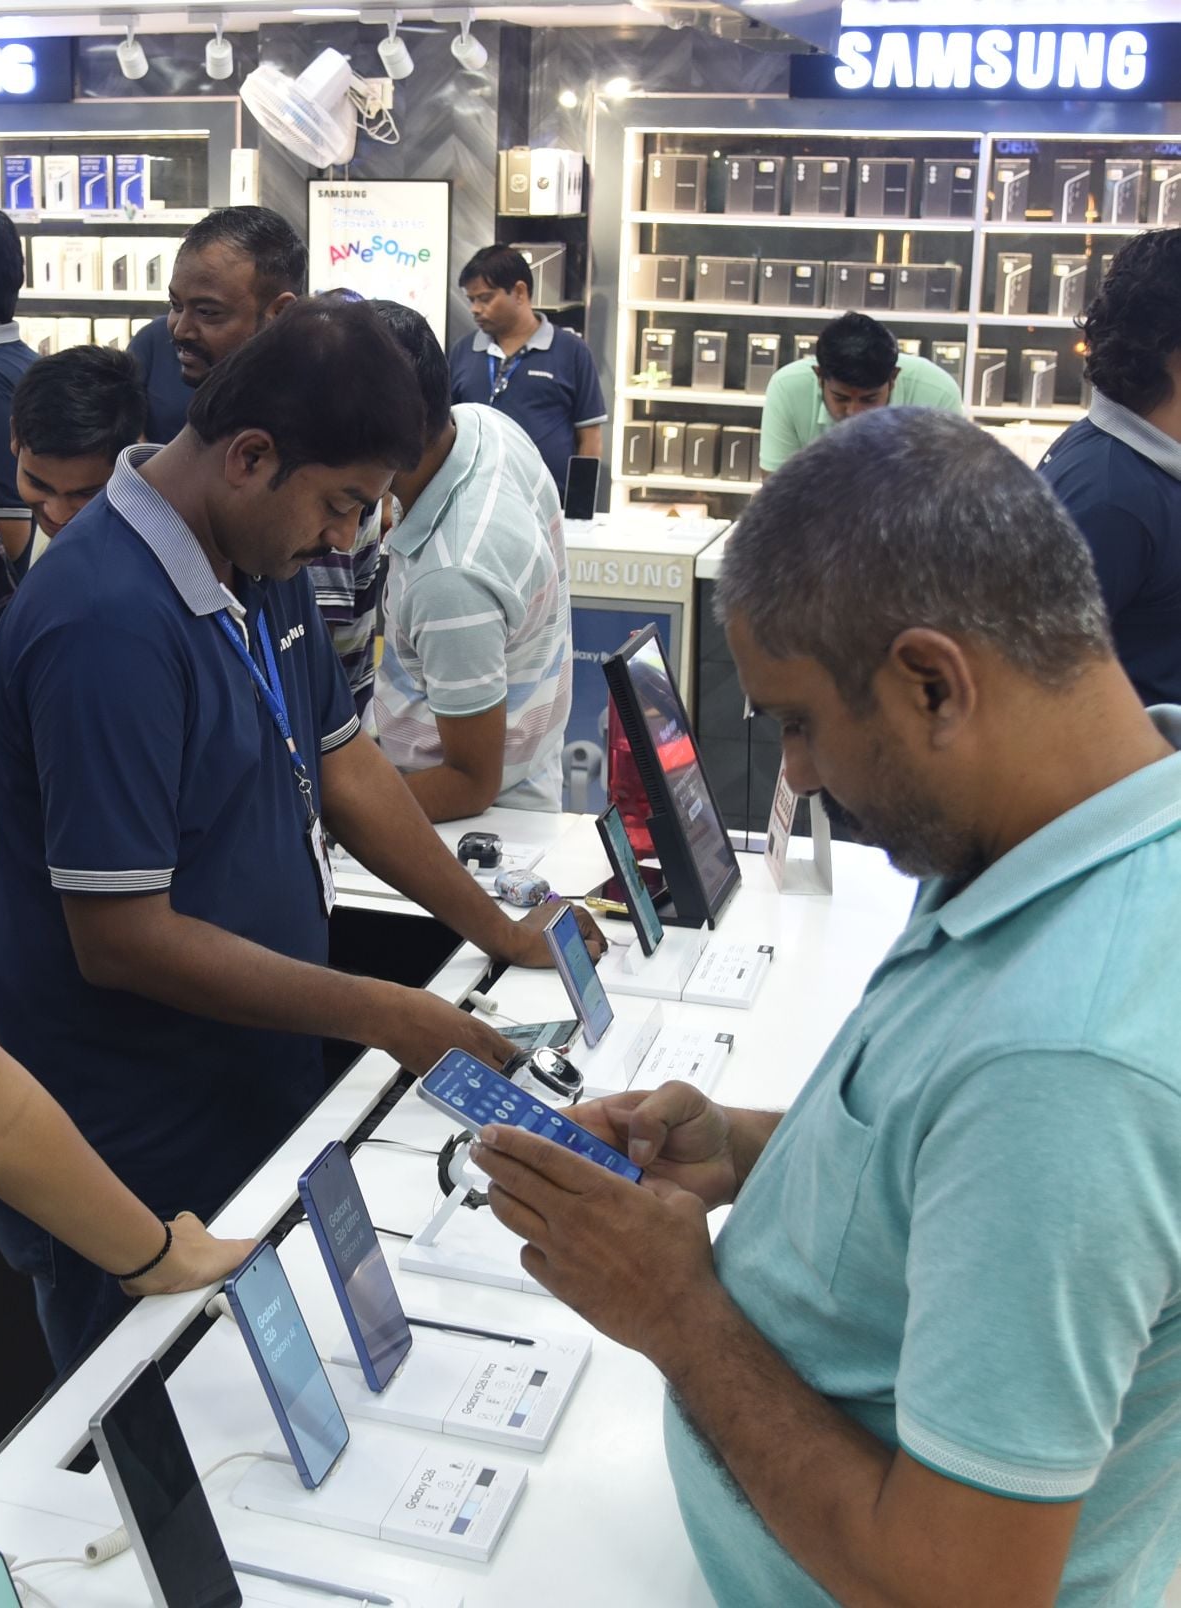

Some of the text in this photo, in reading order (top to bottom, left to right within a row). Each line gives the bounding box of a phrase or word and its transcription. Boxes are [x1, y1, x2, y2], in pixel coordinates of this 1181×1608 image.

[834, 30, 1148, 90] SAMSUNG
[317, 189, 368, 199] SAMSUNG
[575, 559, 684, 589] MSUNG
[329, 1195, 352, 1228] Galaxy
[335, 1210, 361, 1246] S26 Ultra
[341, 1236, 360, 1263] Galaxy
[257, 1295, 282, 1329] Galaxy
[263, 1325, 277, 1347] S26
[271, 1335, 291, 1362] Galaxy
[461, 1363, 498, 1415] Galaxy S26 Ultra
[404, 1469, 436, 1510] Galaxy S26
